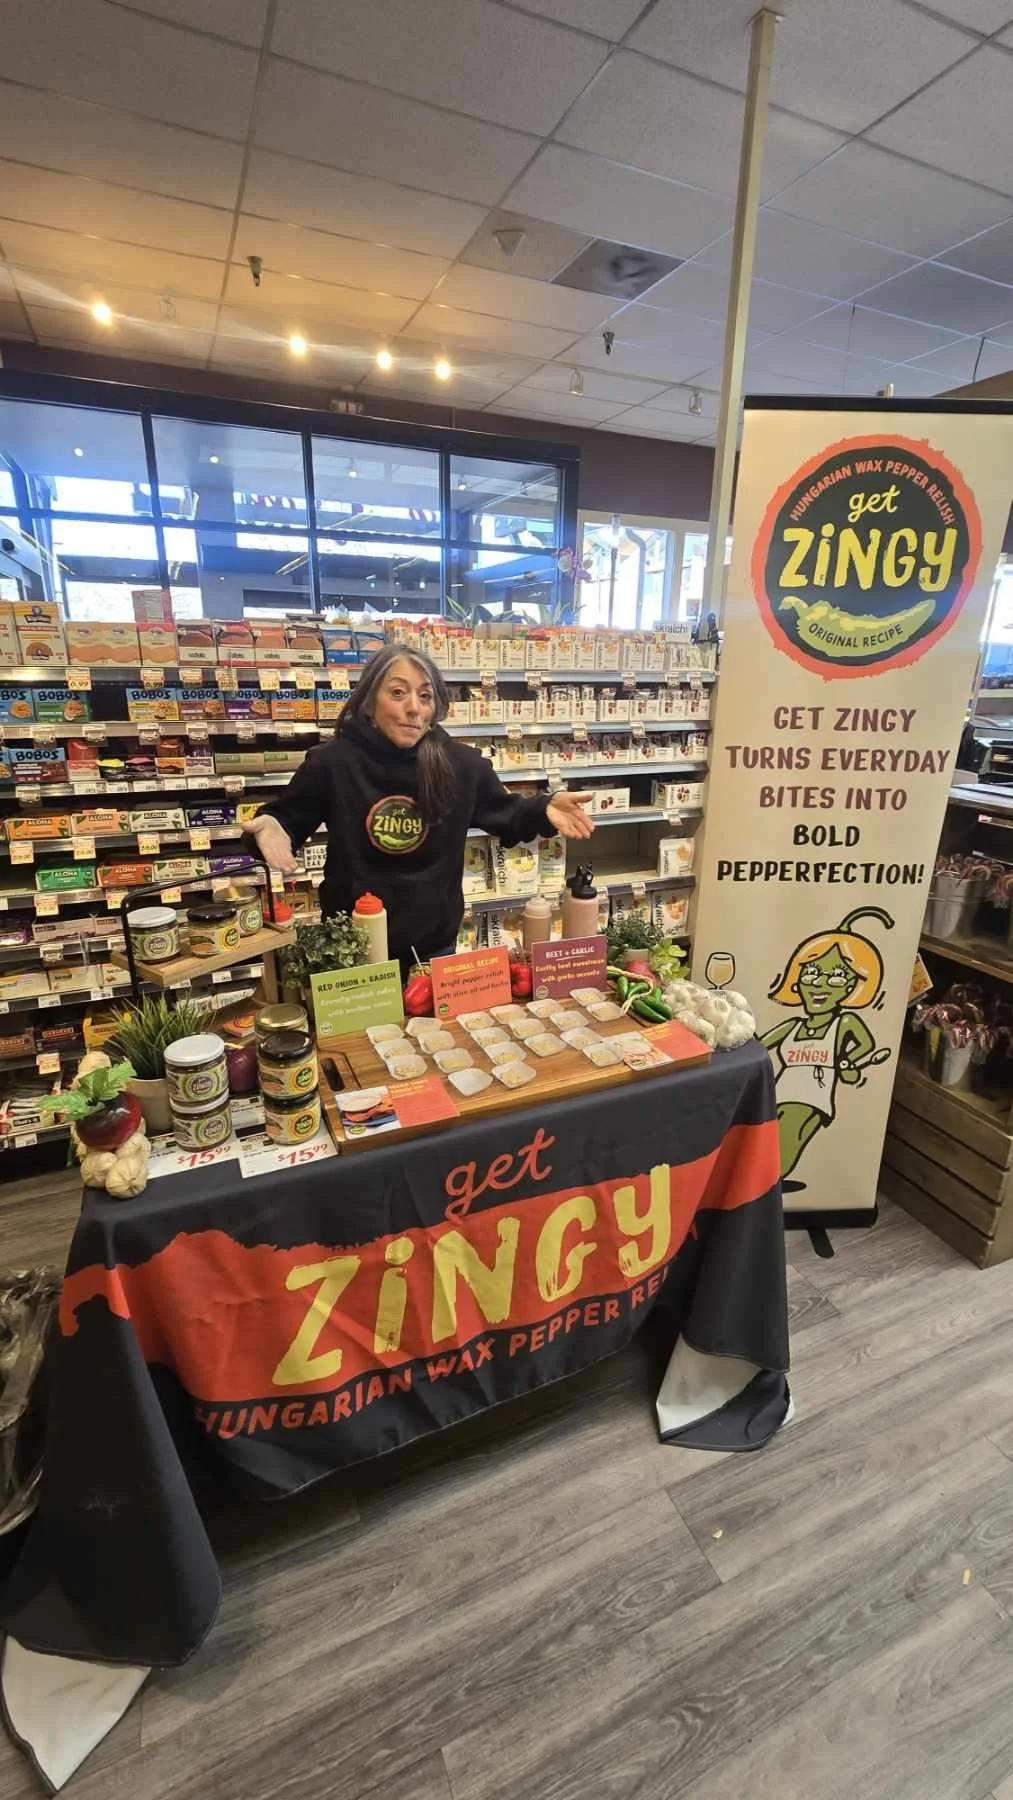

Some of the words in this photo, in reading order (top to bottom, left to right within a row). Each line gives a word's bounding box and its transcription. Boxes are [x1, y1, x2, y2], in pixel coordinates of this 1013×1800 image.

[790, 464, 851, 521] HUNGARIAN
[855, 459, 882, 473] WAX
[885, 460, 929, 490] PEPPER
[926, 483, 956, 525] RELISH
[848, 485, 901, 523] get
[808, 622, 858, 648] ORIGINAL
[863, 624, 904, 648] RECIPE
[773, 706, 824, 730] GET
[833, 707, 917, 732] ZINGY
[725, 745, 812, 770] TURNS
[821, 748, 951, 774] EVERYDAY
[759, 785, 836, 809] BITES
[845, 787, 907, 811] INTO
[793, 824, 860, 847] BOLD
[717, 860, 925, 884] PEPPERFECTION!
[545, 950, 562, 959] BEET
[317, 983, 333, 992] RED
[444, 1127, 555, 1221] get
[195, 1368, 412, 1439] HUNGARIAN
[427, 1337, 496, 1384] WAX
[510, 1302, 620, 1357] PEPPER
